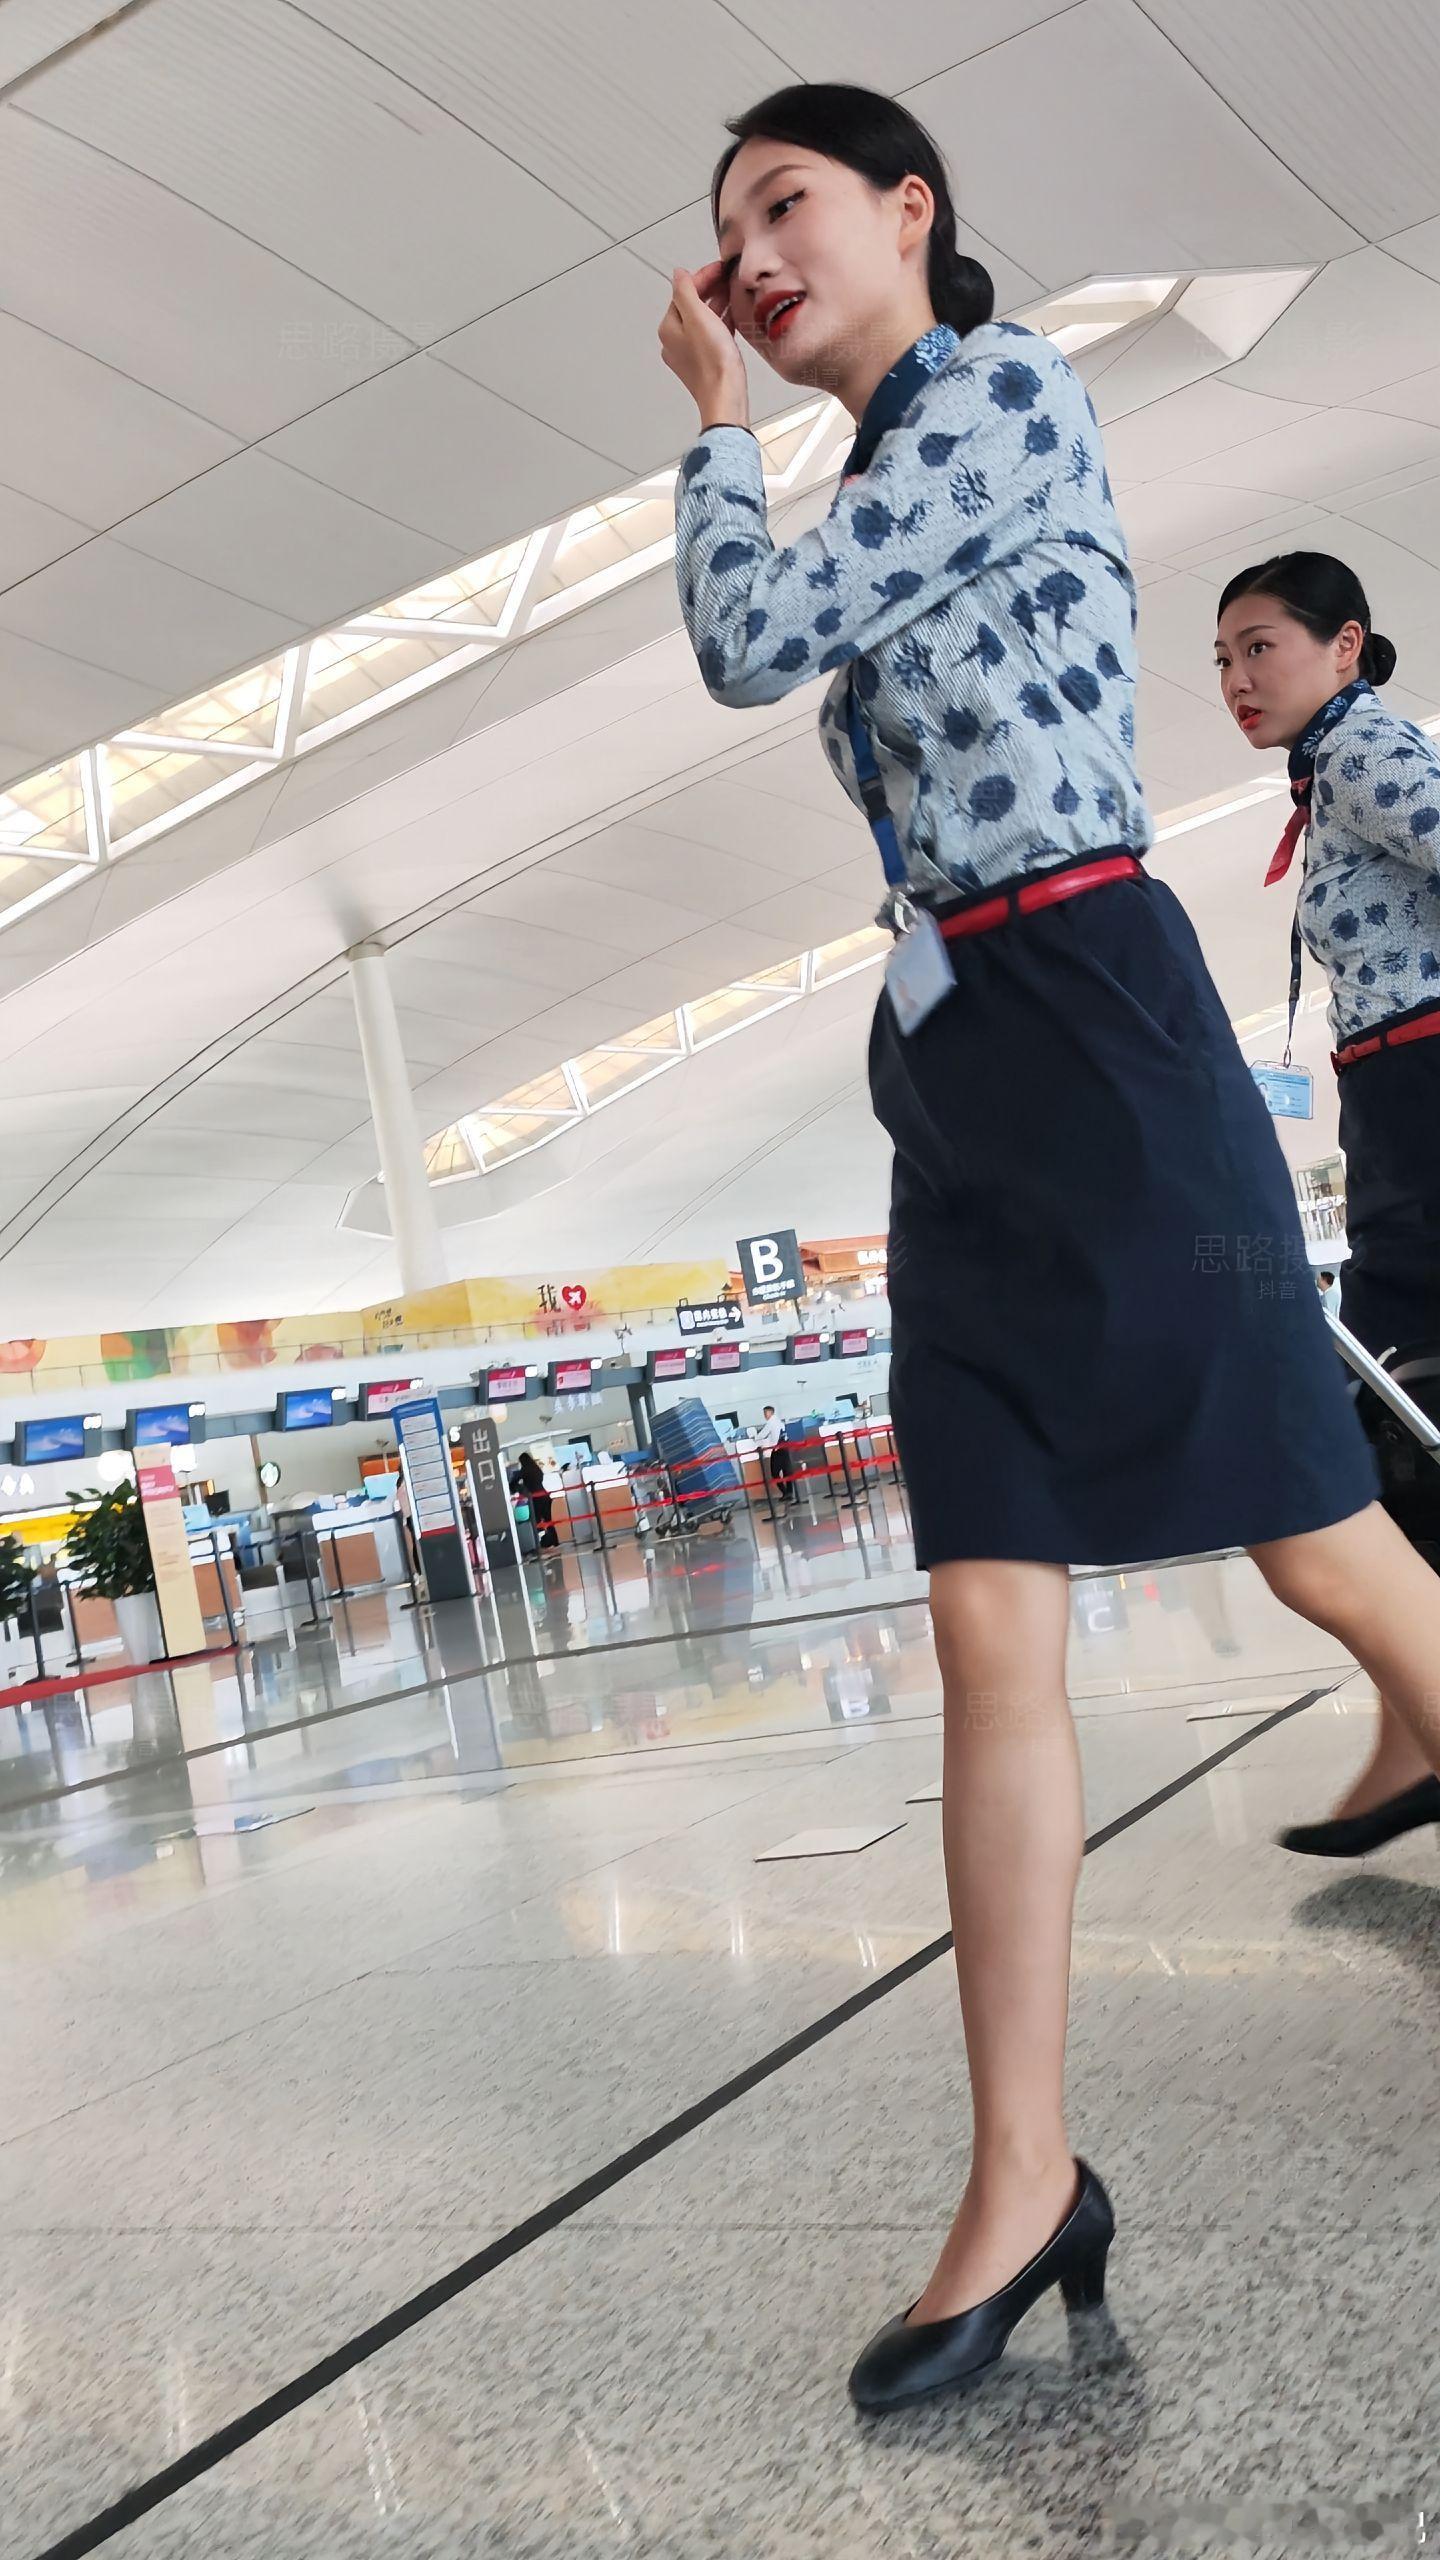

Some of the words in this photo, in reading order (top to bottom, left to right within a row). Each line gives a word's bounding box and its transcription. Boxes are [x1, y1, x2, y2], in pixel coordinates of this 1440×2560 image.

[750, 1239, 784, 1284] B
[537, 1284, 562, 1314] 我
[472, 1428, 496, 1483] 出口
